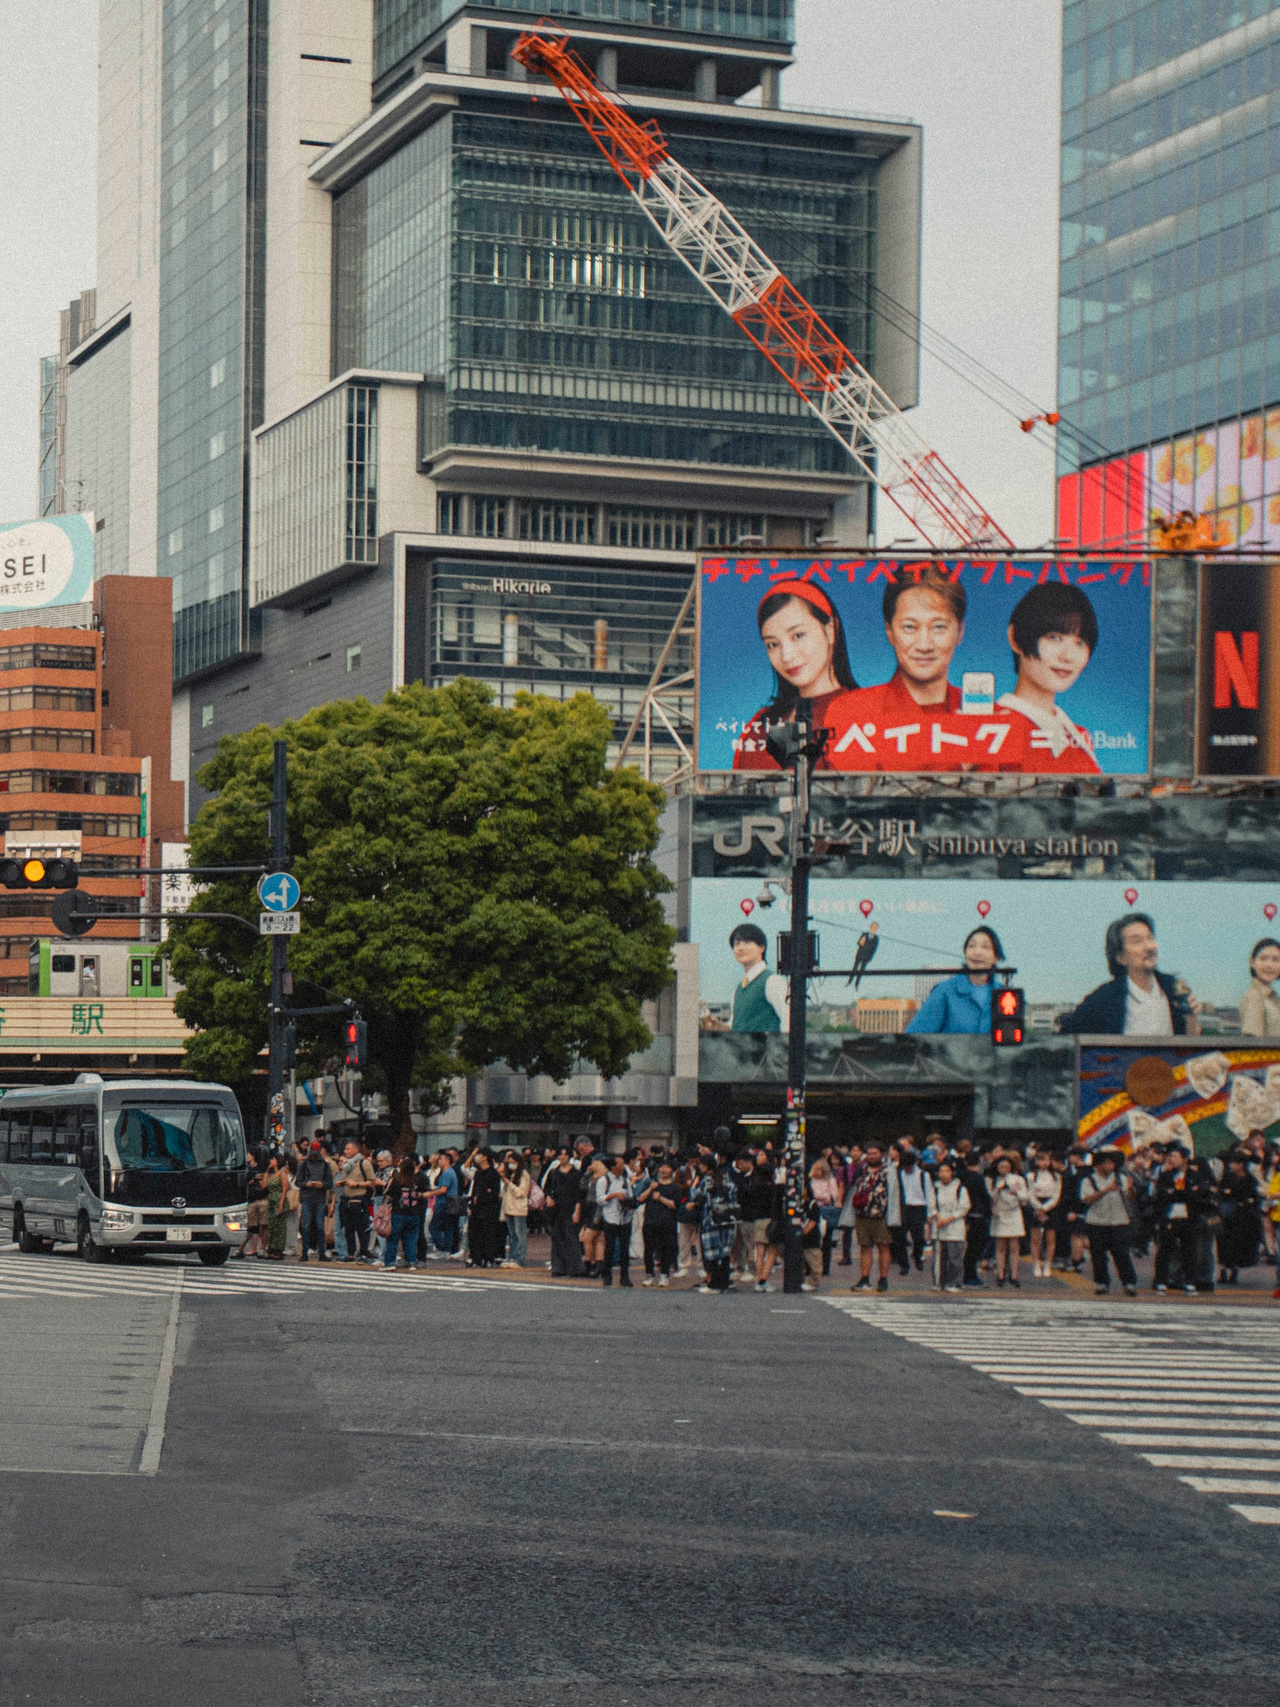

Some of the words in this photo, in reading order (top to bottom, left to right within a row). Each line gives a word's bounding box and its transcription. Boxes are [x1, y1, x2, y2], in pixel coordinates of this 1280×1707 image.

[492, 577, 552, 596] Hikarie
[1214, 631, 1259, 710] N
[713, 815, 786, 857] JR
[927, 833, 1027, 858] shibuya
[1034, 834, 1120, 857] station
